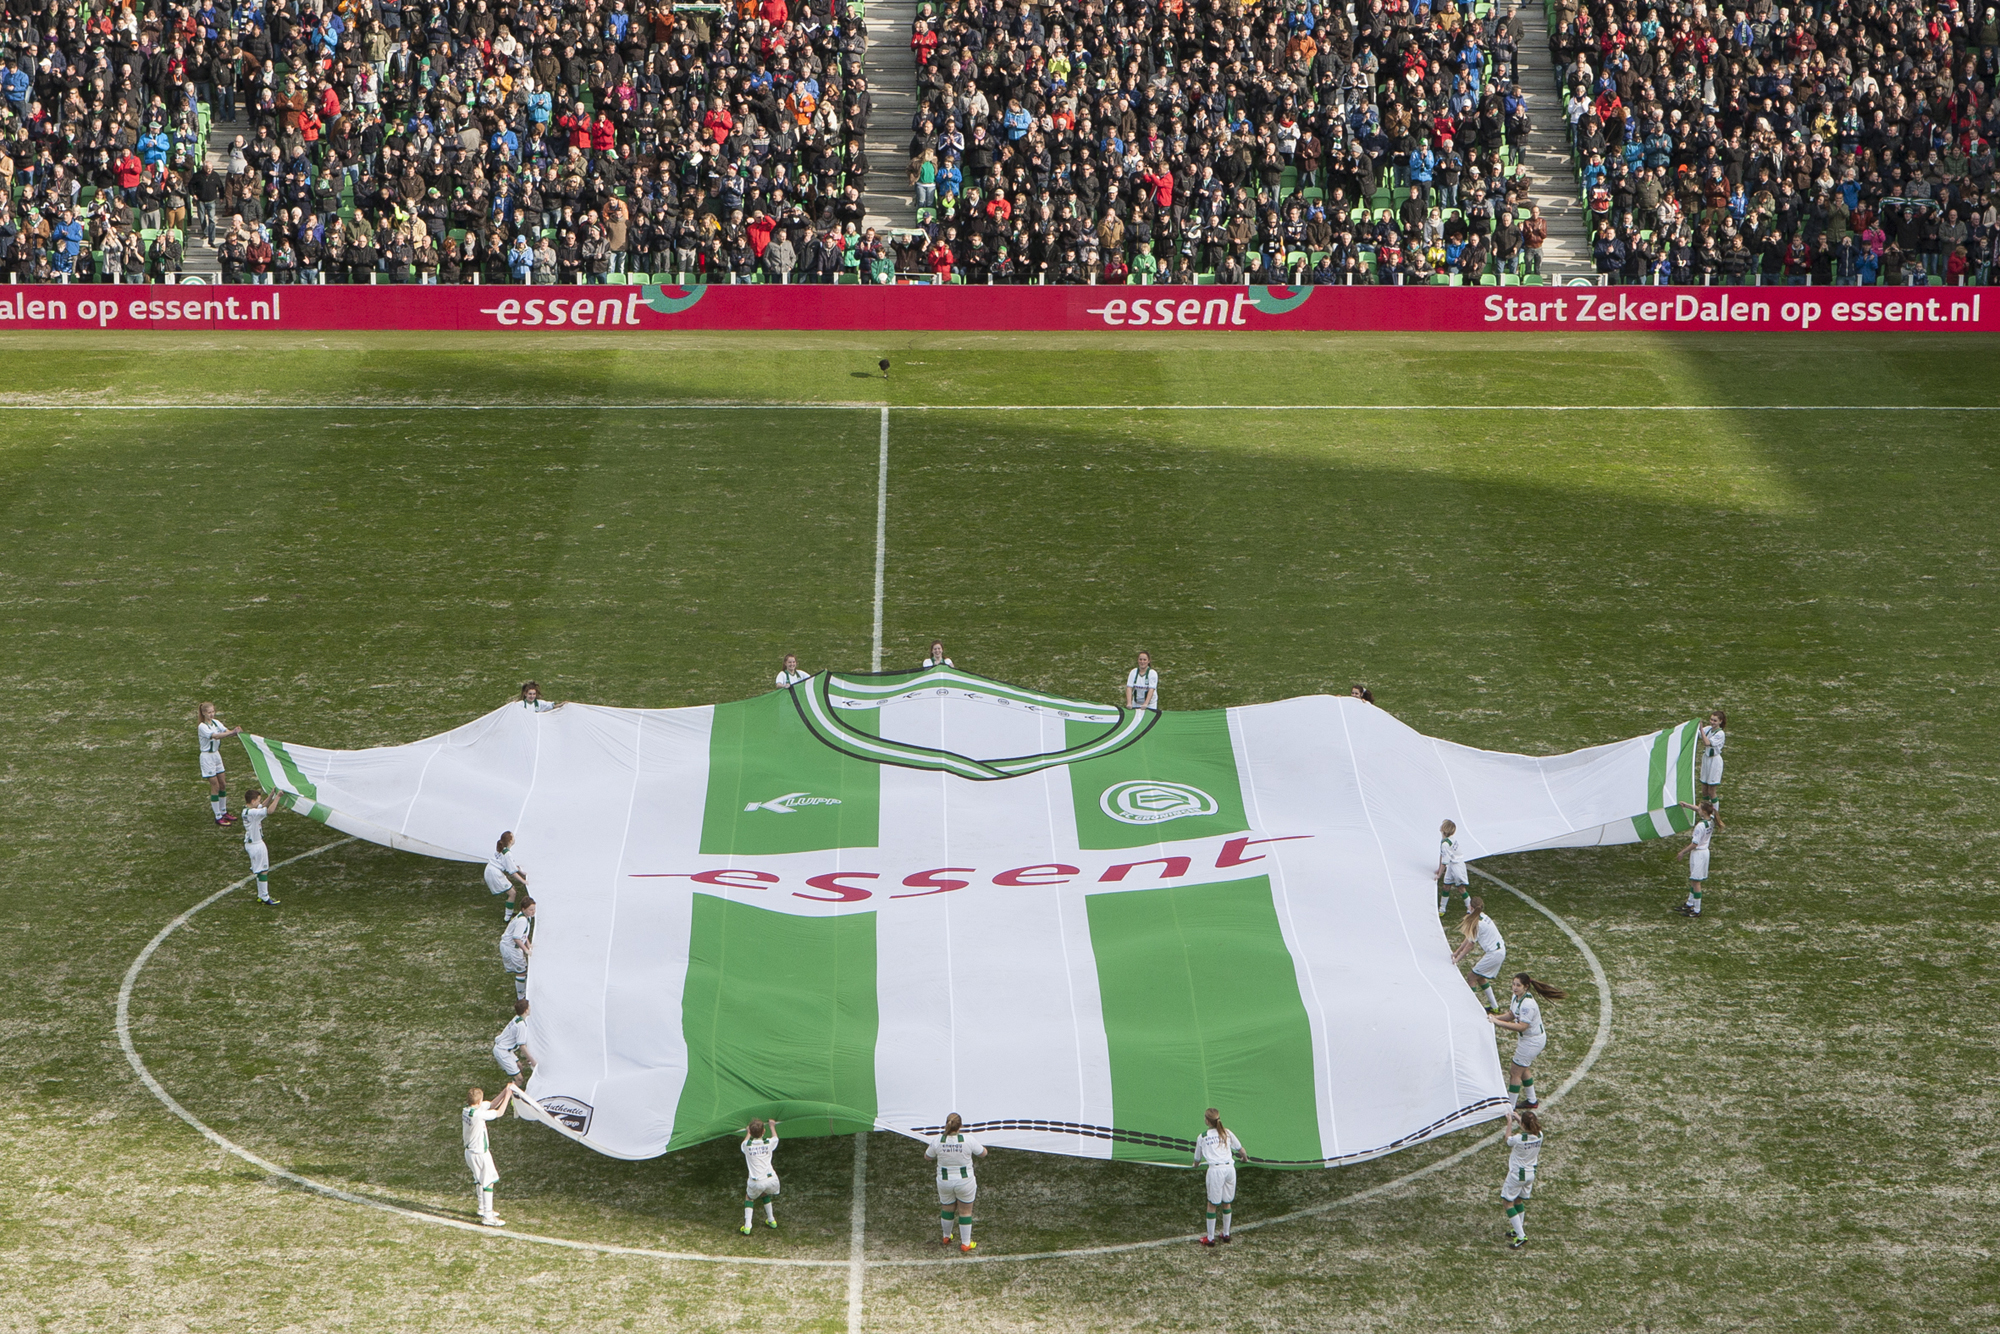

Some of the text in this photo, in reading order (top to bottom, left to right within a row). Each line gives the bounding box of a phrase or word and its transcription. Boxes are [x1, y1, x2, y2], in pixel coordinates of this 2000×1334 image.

[0, 292, 280, 326] alen op essent.nl
[480, 293, 654, 325] essent
[1087, 293, 1260, 325] essent
[1484, 293, 1981, 328] Start ZekerDalen op essent.nl
[628, 835, 1315, 903] essent
[543, 1102, 584, 1116] Authentic
